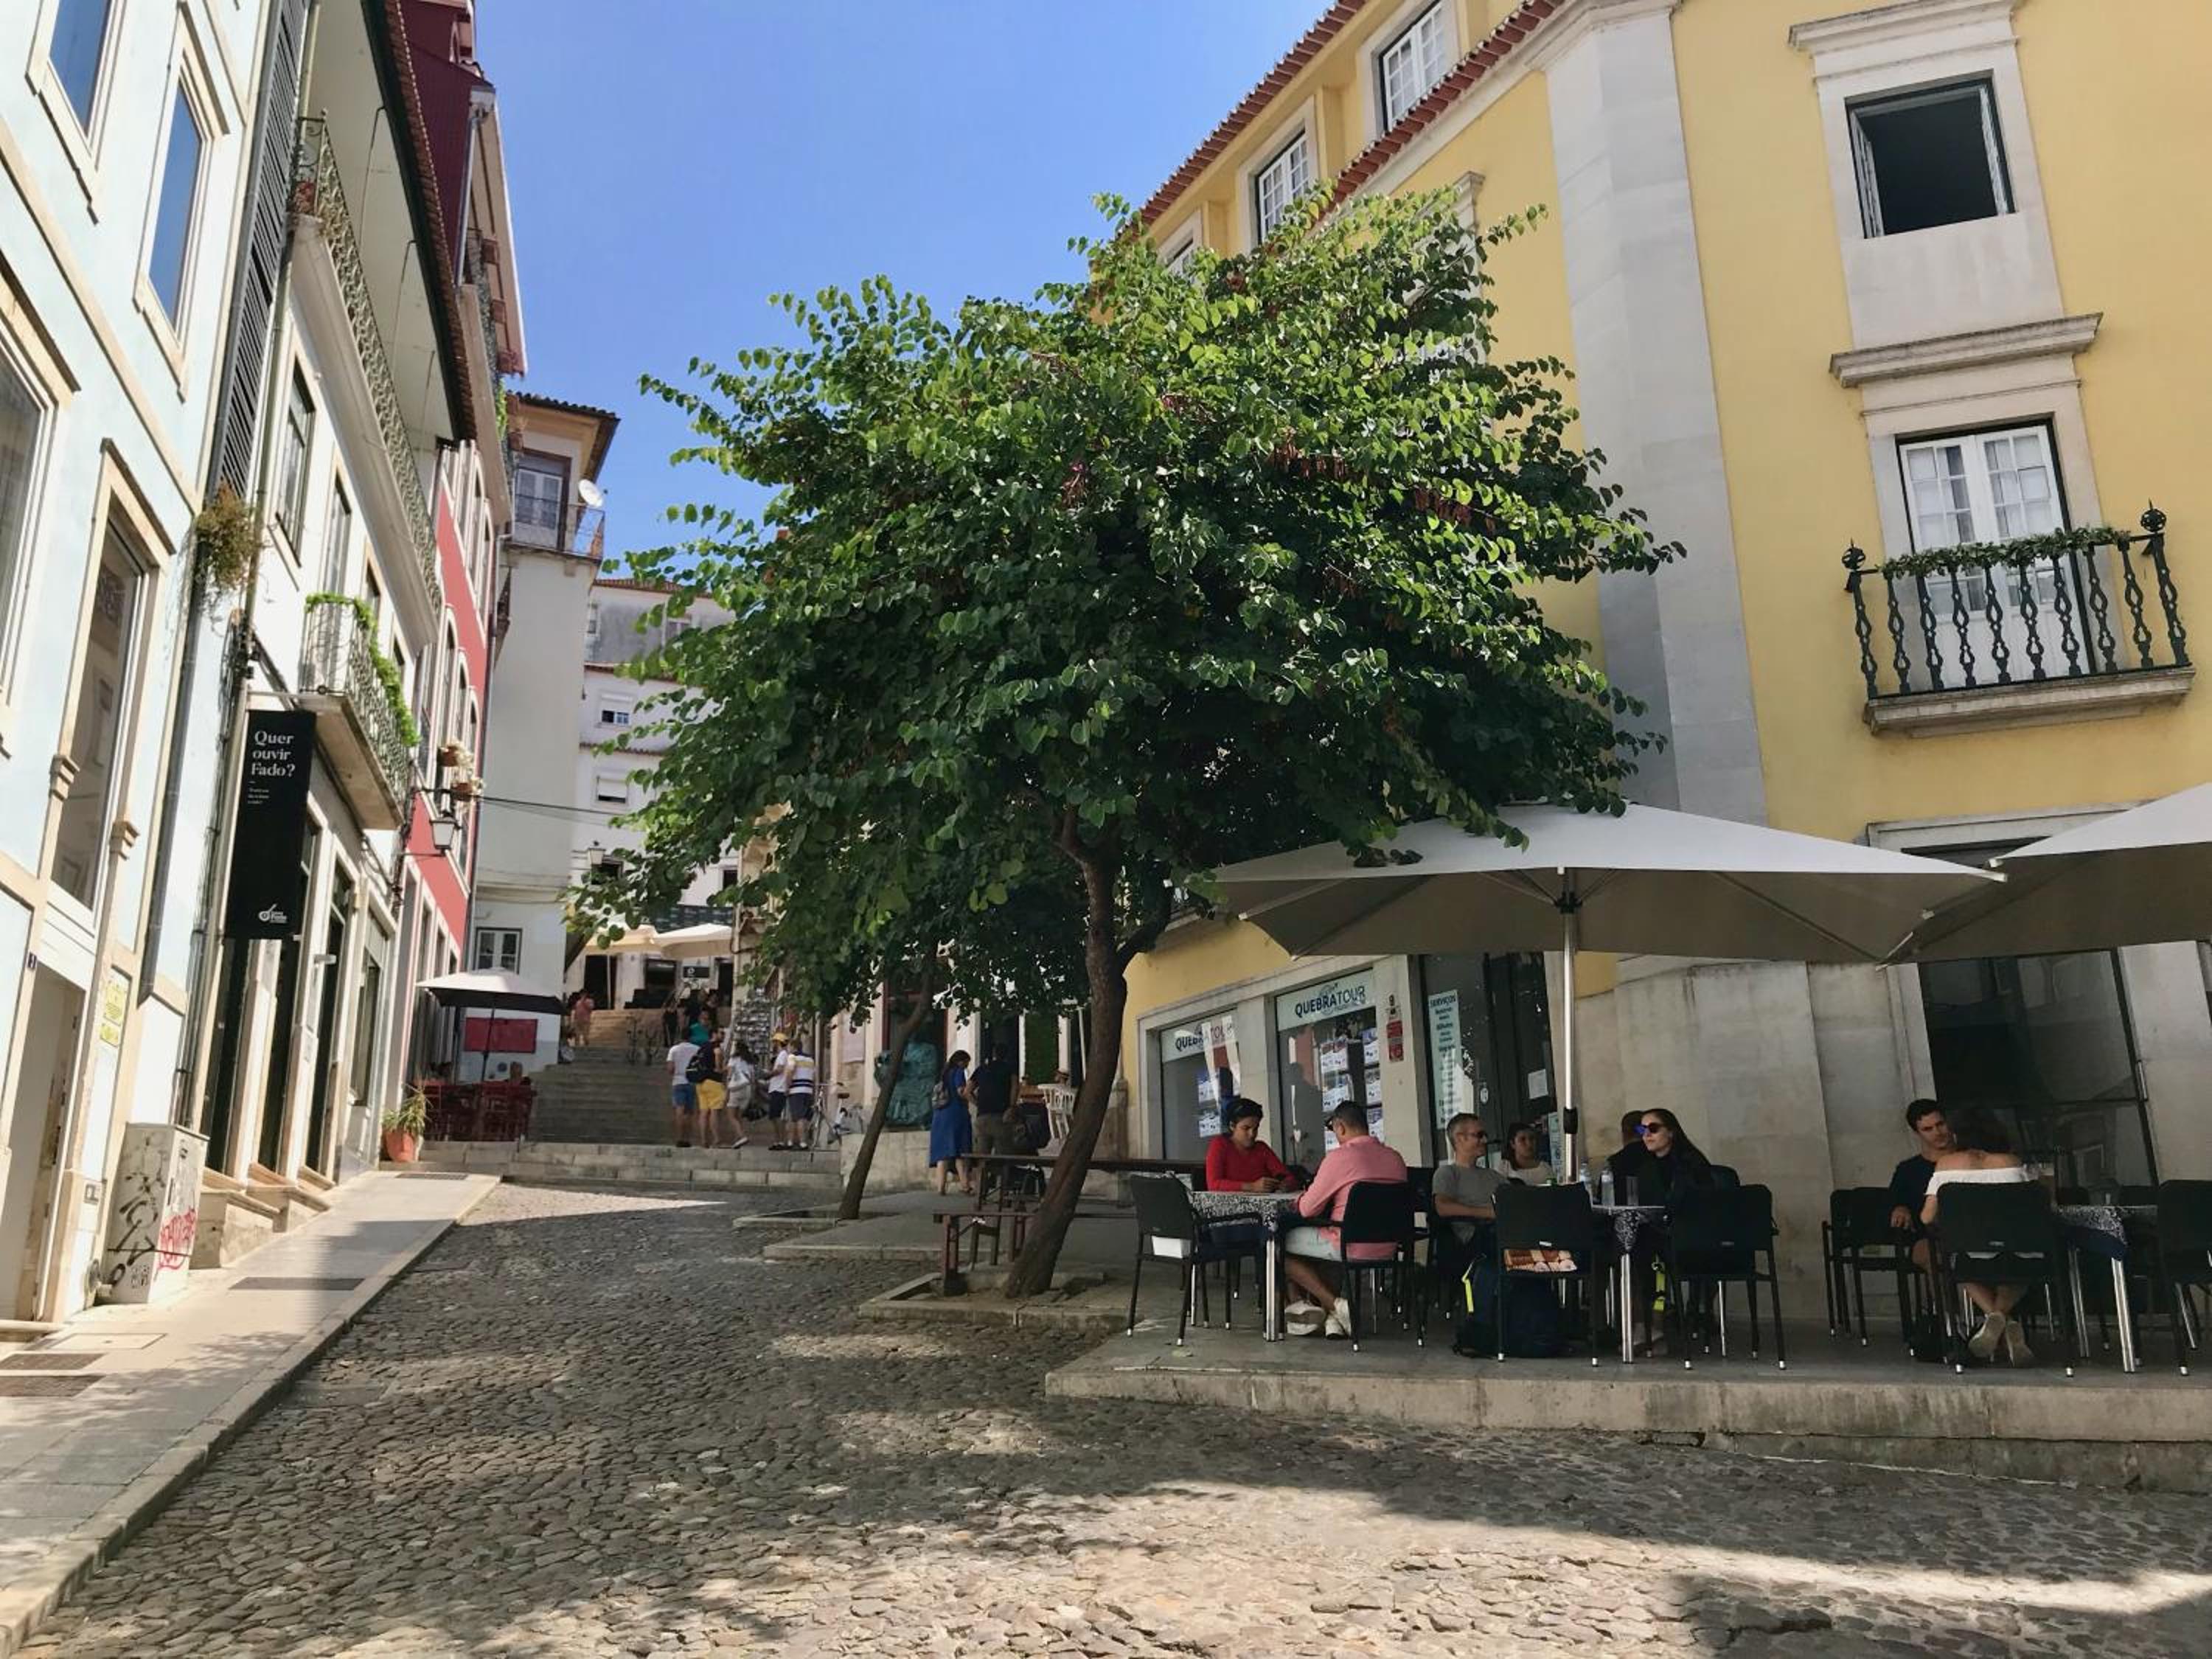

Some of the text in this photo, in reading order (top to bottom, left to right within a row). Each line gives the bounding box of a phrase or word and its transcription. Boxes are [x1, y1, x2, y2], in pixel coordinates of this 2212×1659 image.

[254, 731, 294, 746] Quer
[252, 748, 291, 760] ouvir
[251, 762, 295, 778] Fado?
